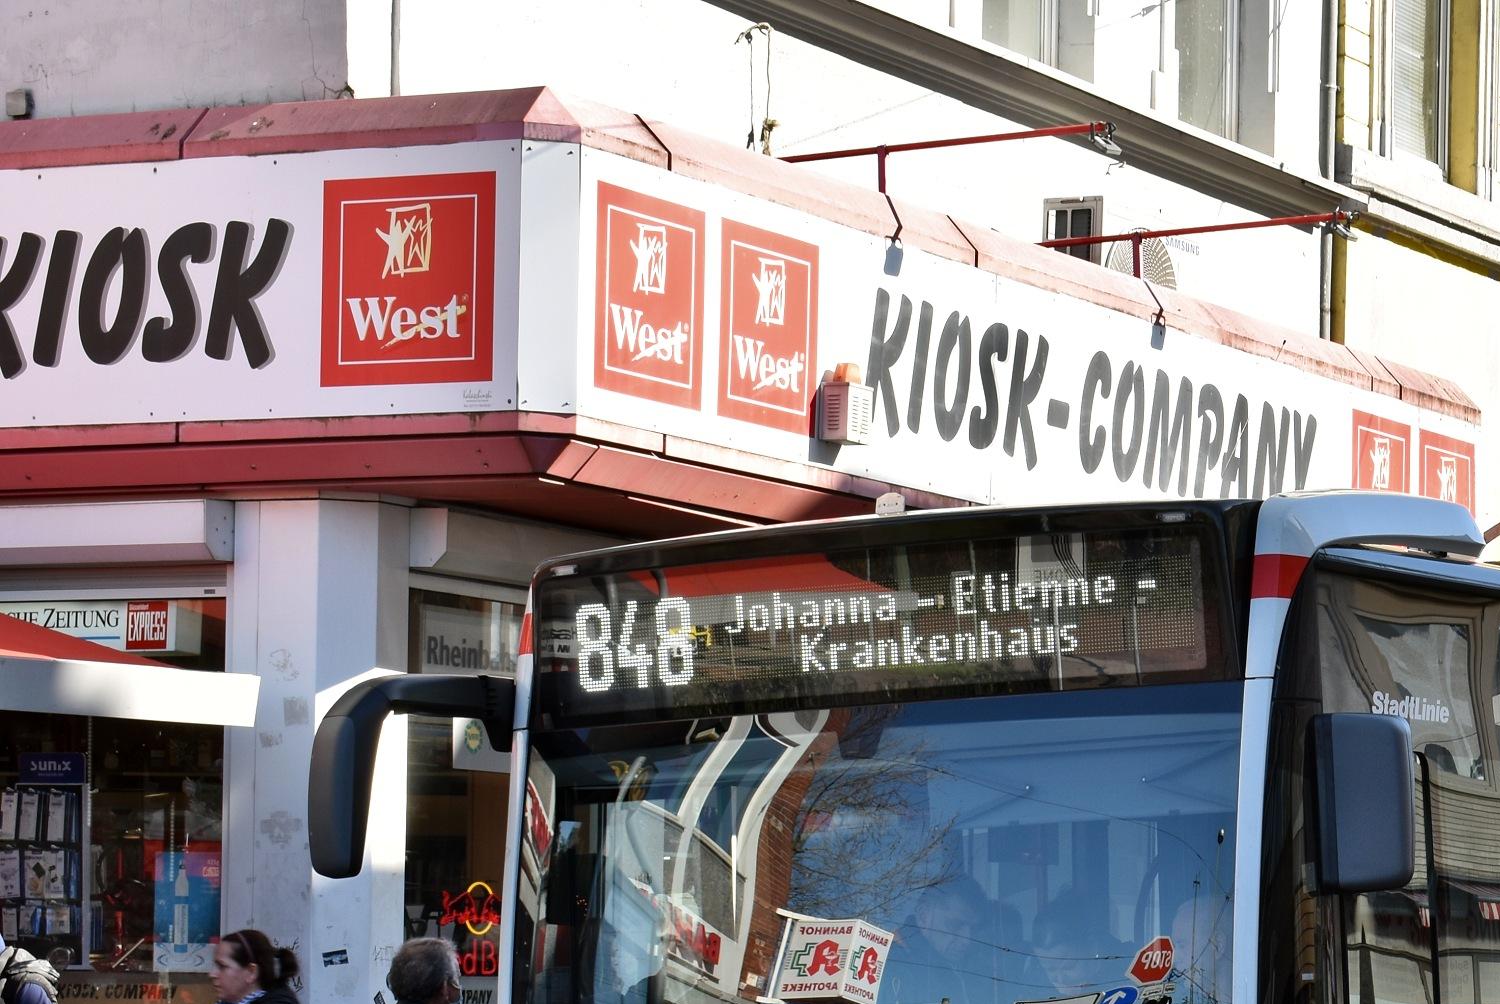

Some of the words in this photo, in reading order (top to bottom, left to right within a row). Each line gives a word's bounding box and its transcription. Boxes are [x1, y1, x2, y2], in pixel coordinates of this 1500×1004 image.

[1165, 235, 1200, 256] SAMSUNG
[346, 294, 461, 344] West
[610, 303, 688, 365] West
[733, 334, 805, 393] West
[867, 287, 1317, 499] KIOSK-COMPANY
[43, 608, 119, 629] ZEITUNG
[128, 611, 166, 642] EXPRESS
[724, 592, 897, 633] Johanna
[954, 572, 1116, 615] Etienne
[575, 596, 694, 693] 848
[800, 620, 1079, 673] Krankenhaus
[1371, 690, 1450, 724] StadtLinie
